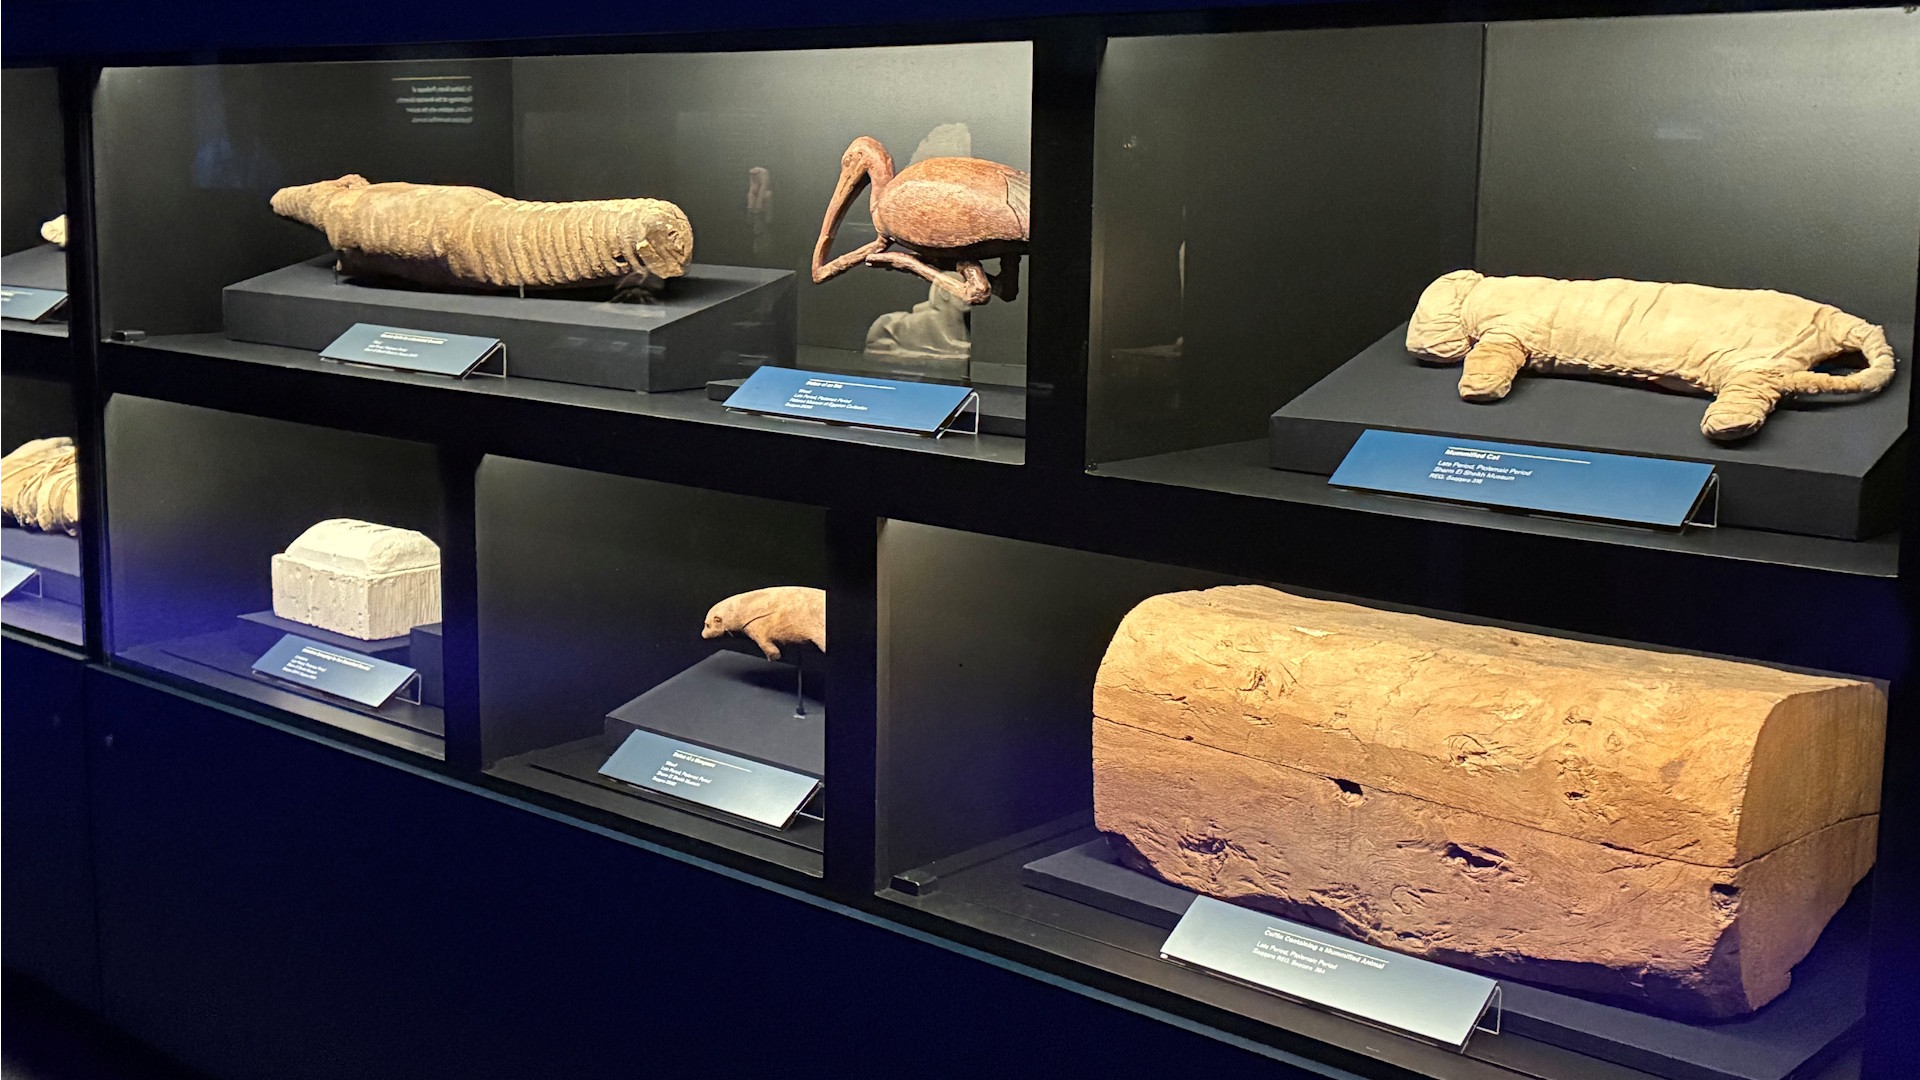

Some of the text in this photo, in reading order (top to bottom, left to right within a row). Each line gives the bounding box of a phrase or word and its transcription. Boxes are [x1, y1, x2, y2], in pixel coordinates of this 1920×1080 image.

[1445, 449, 1486, 459] Mummified
[1509, 468, 1533, 476] Period
[1486, 473, 1515, 481] Museum
[1361, 958, 1385, 970] Animal
